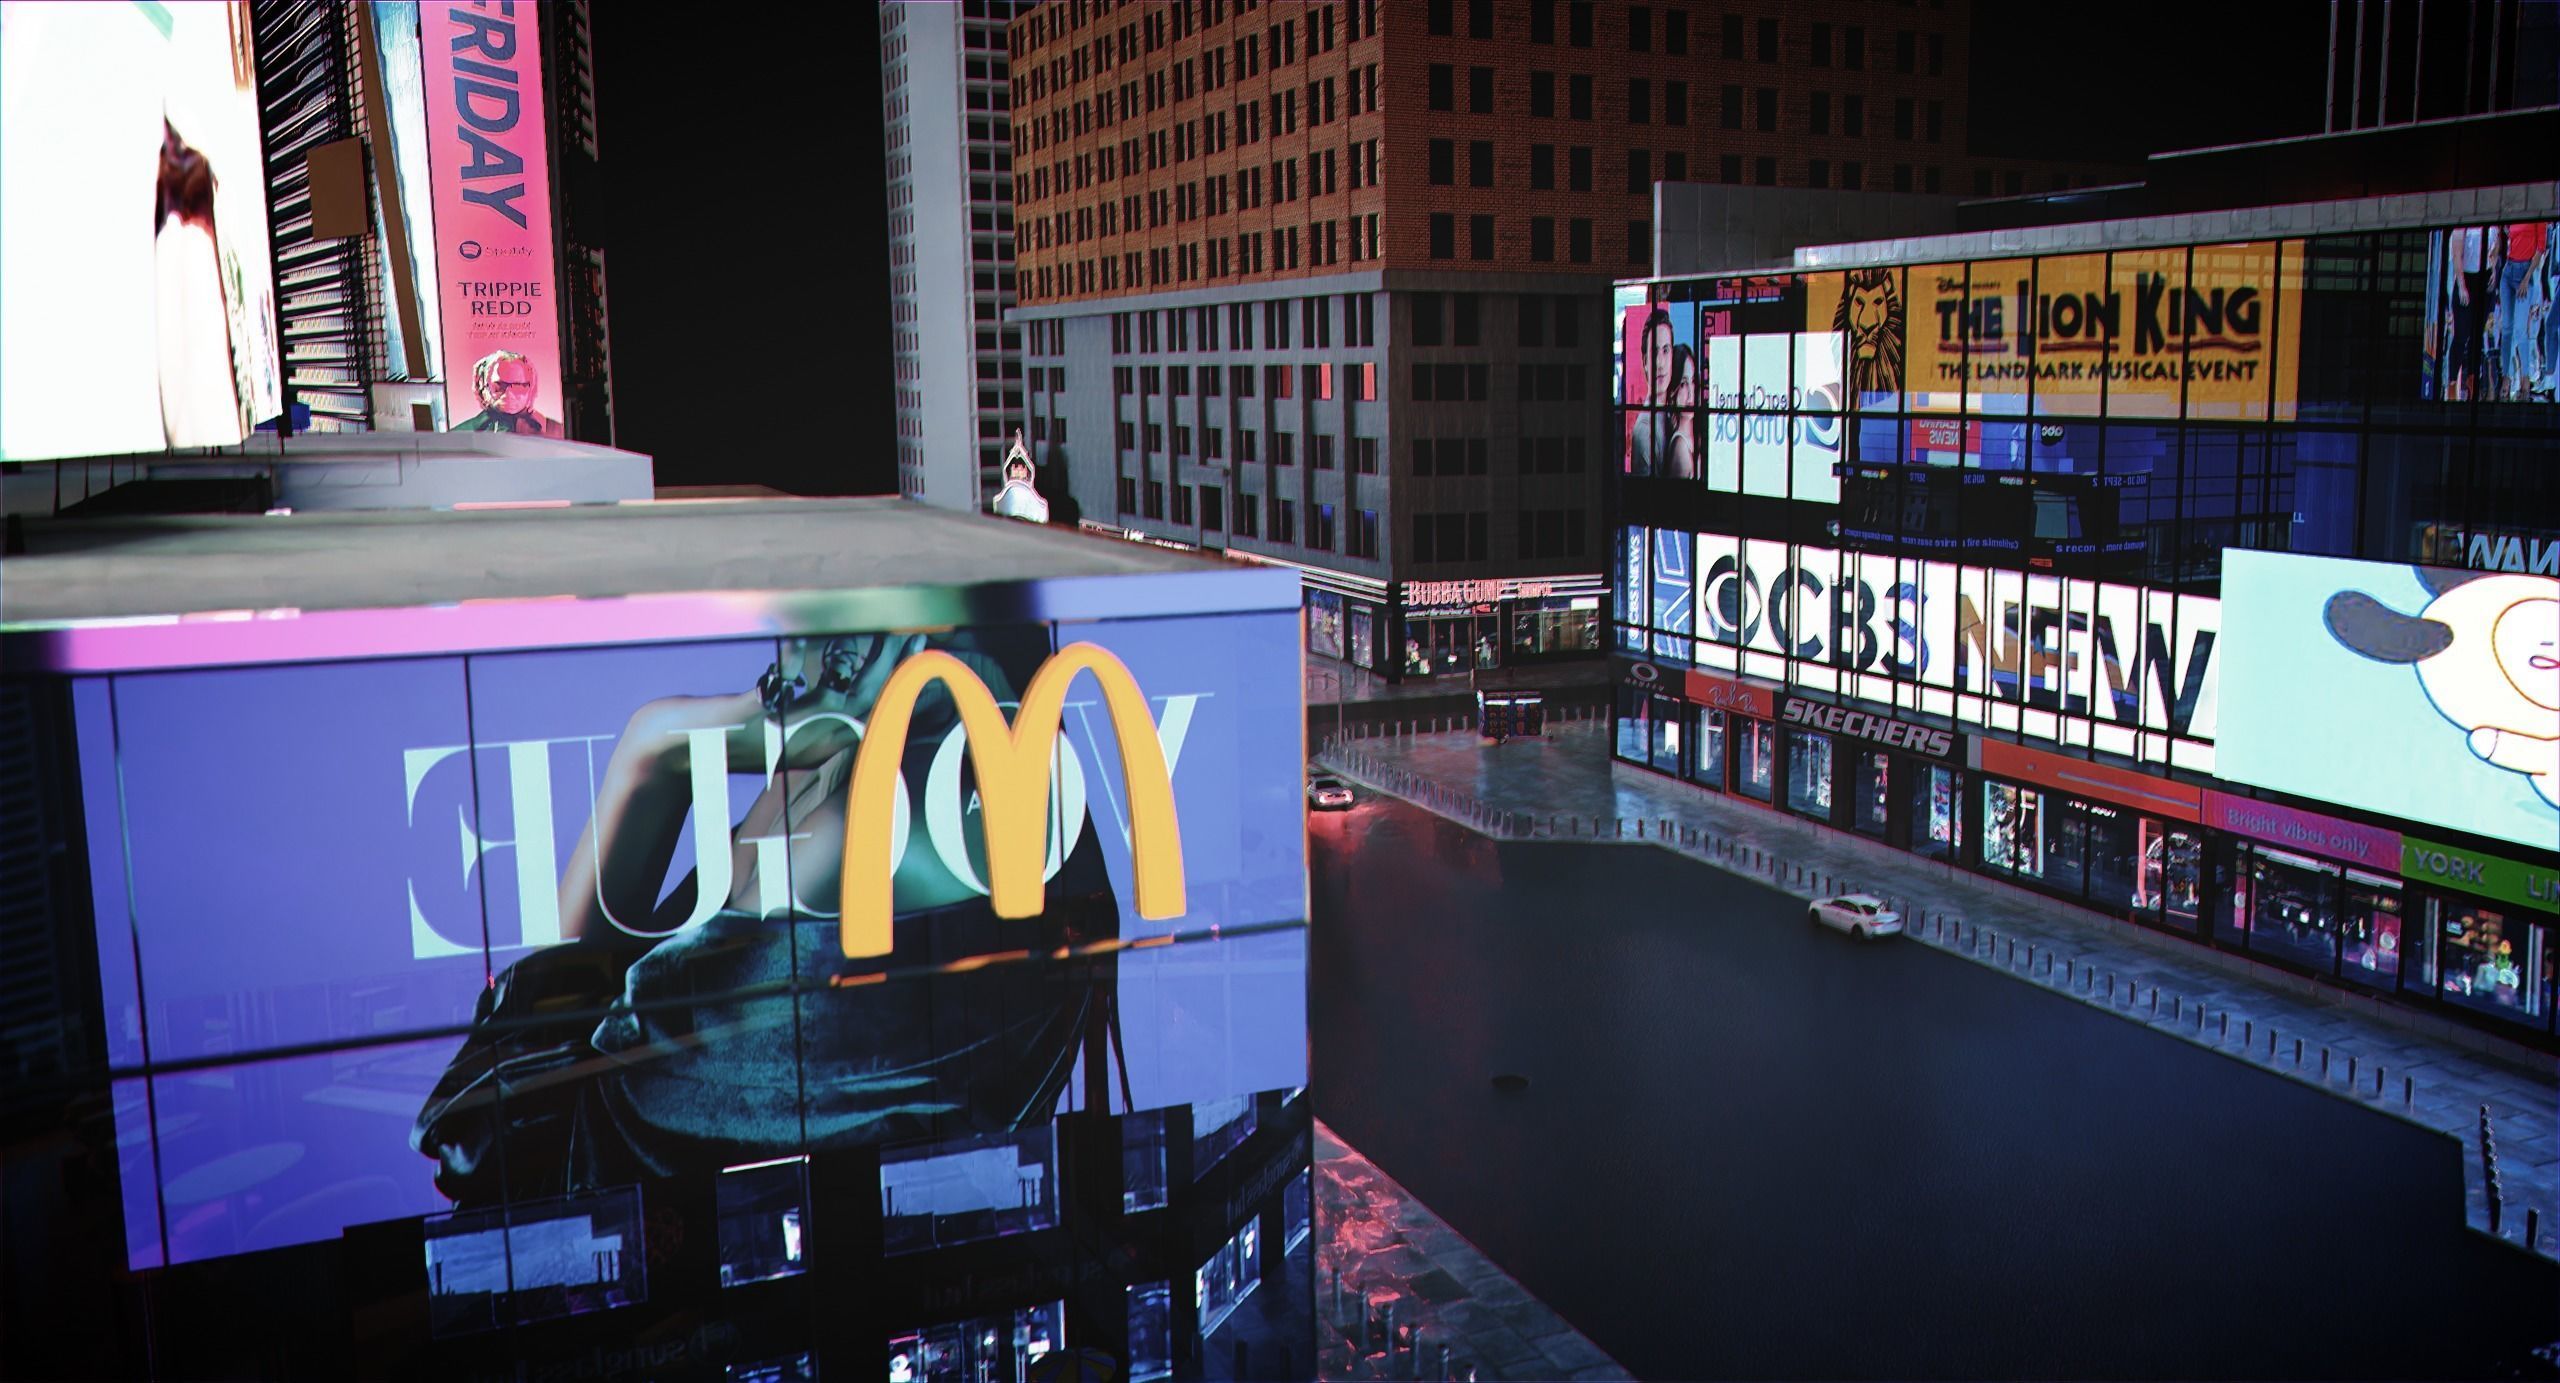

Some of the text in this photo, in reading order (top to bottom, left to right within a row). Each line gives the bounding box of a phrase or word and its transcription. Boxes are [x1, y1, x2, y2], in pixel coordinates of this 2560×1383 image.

[458, 281, 542, 297] TRIPPIE
[471, 300, 532, 316] REDD
[1935, 272, 2262, 356] THE LION KING
[1938, 359, 2260, 382] THE LANDMARK MUSICAL EVENT
[1408, 580, 1462, 607] BUBBA
[1769, 564, 1930, 677] CBS
[1782, 697, 1955, 758] SKECHERS
[2227, 808, 2370, 859] Bright vibes only
[2413, 846, 2487, 886] YORK
